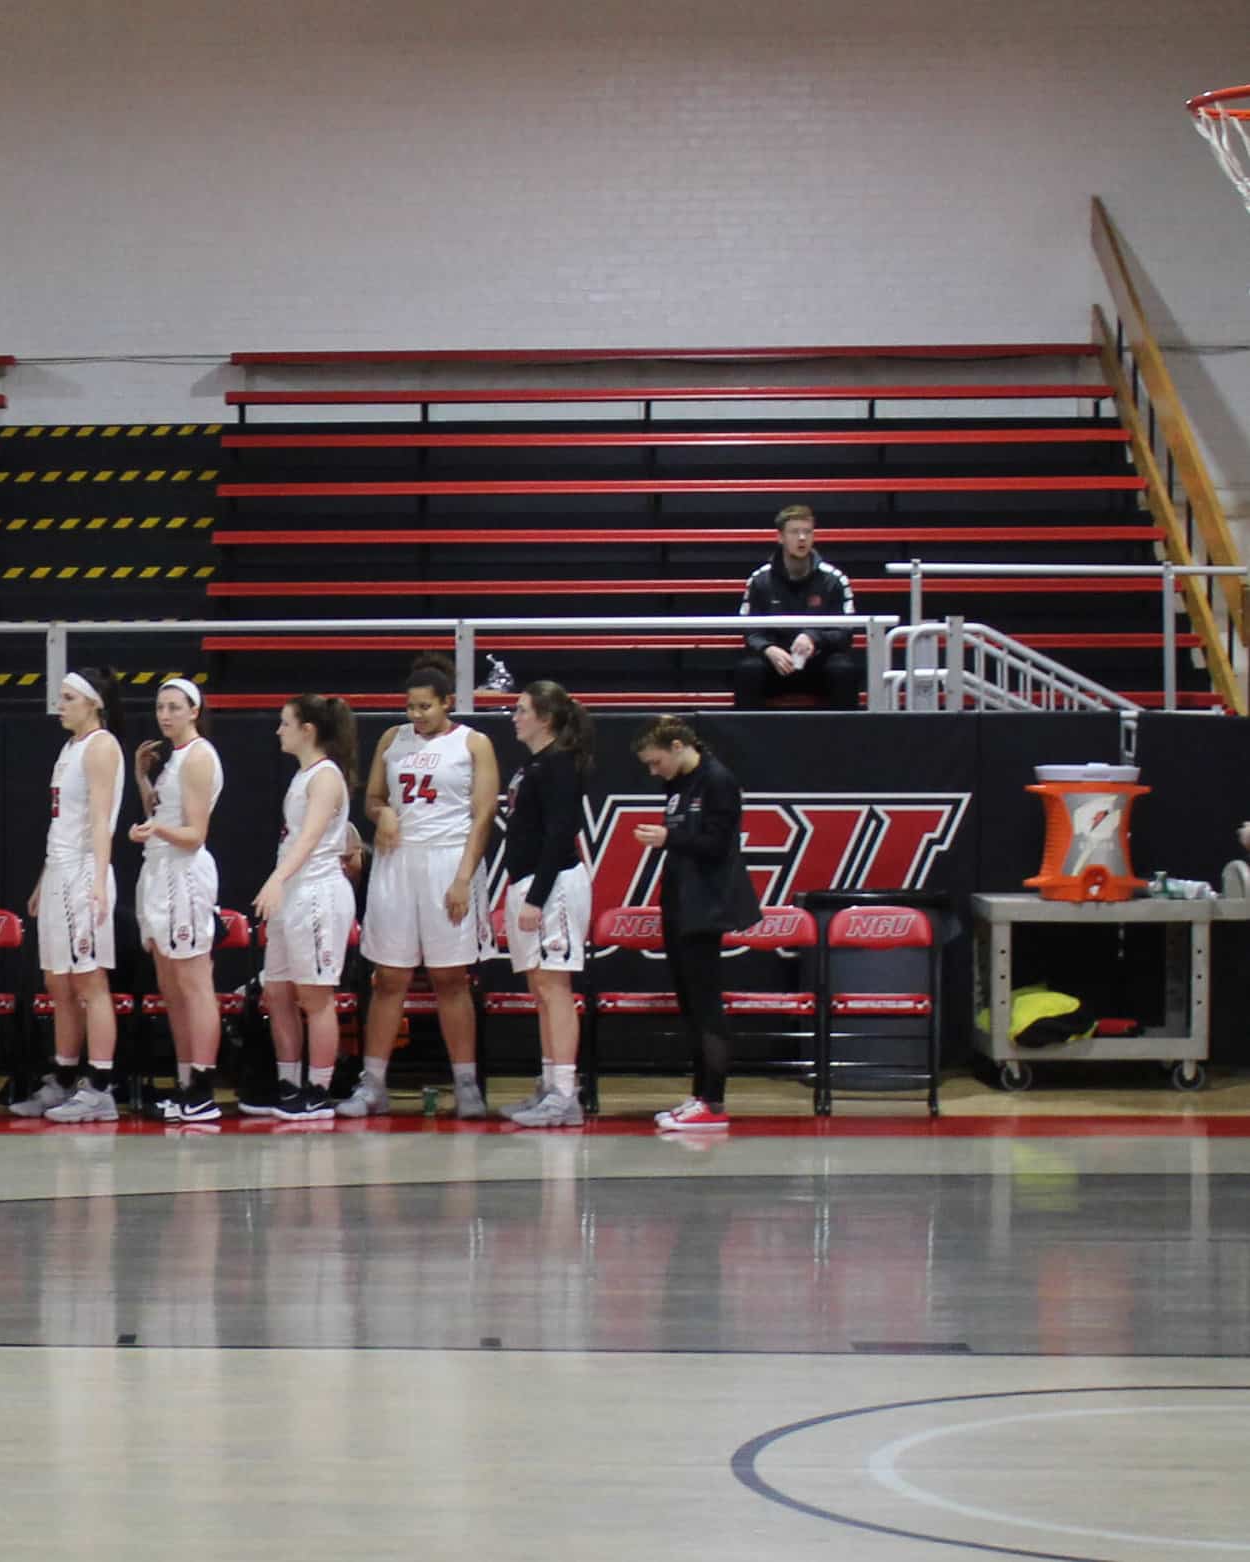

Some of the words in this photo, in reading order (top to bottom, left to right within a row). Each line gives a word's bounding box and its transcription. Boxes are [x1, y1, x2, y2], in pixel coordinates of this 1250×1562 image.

[399, 773, 437, 804] 24
[609, 914, 662, 937] NG
[845, 914, 916, 937] NGU
